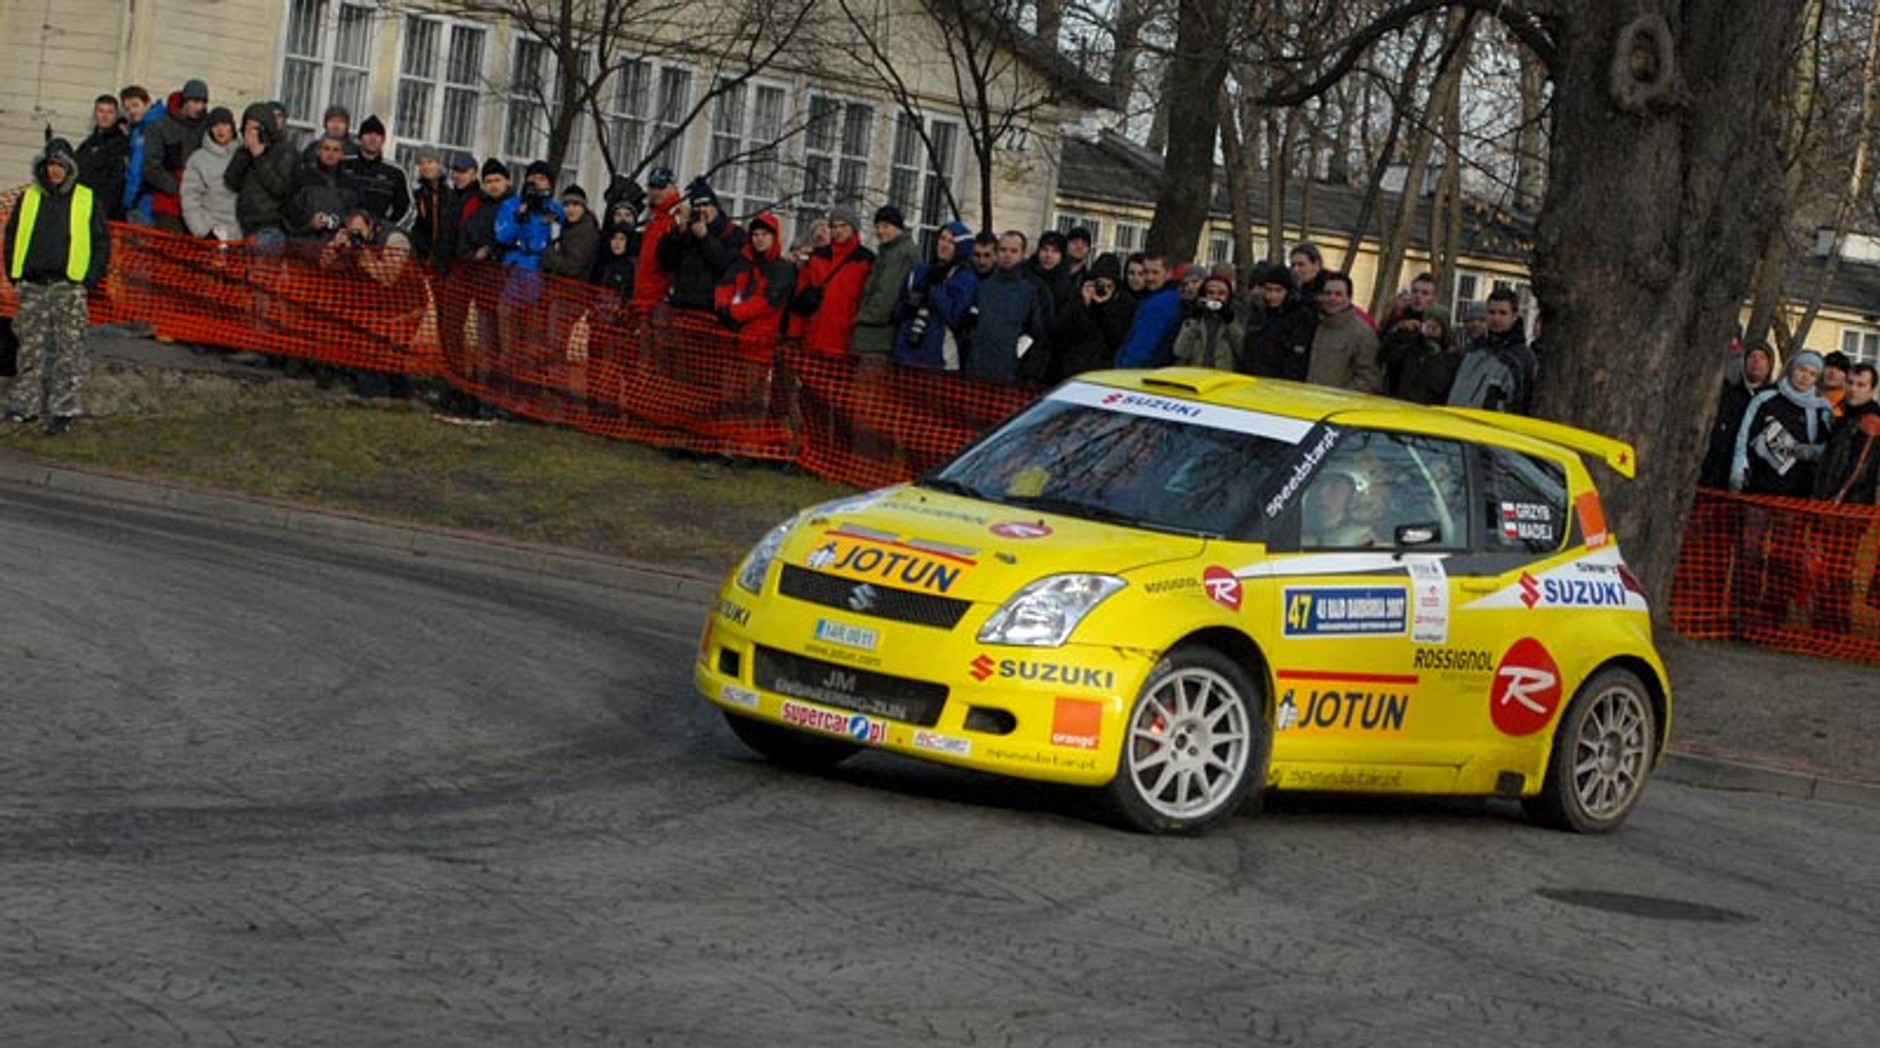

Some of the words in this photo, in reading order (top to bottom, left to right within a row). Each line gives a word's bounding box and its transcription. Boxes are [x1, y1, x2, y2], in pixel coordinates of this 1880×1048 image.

[1122, 395, 1201, 418] SUZUKI
[1517, 522, 1553, 540] MADEJ
[834, 545, 961, 594] JOTUN
[1543, 578, 1626, 606] SUZUKI
[1287, 593, 1313, 632] 47
[822, 671, 857, 691] JM
[1000, 660, 1114, 688] SUZUKI
[1298, 690, 1409, 731] JOTUN
[1052, 733, 1097, 747] orange
